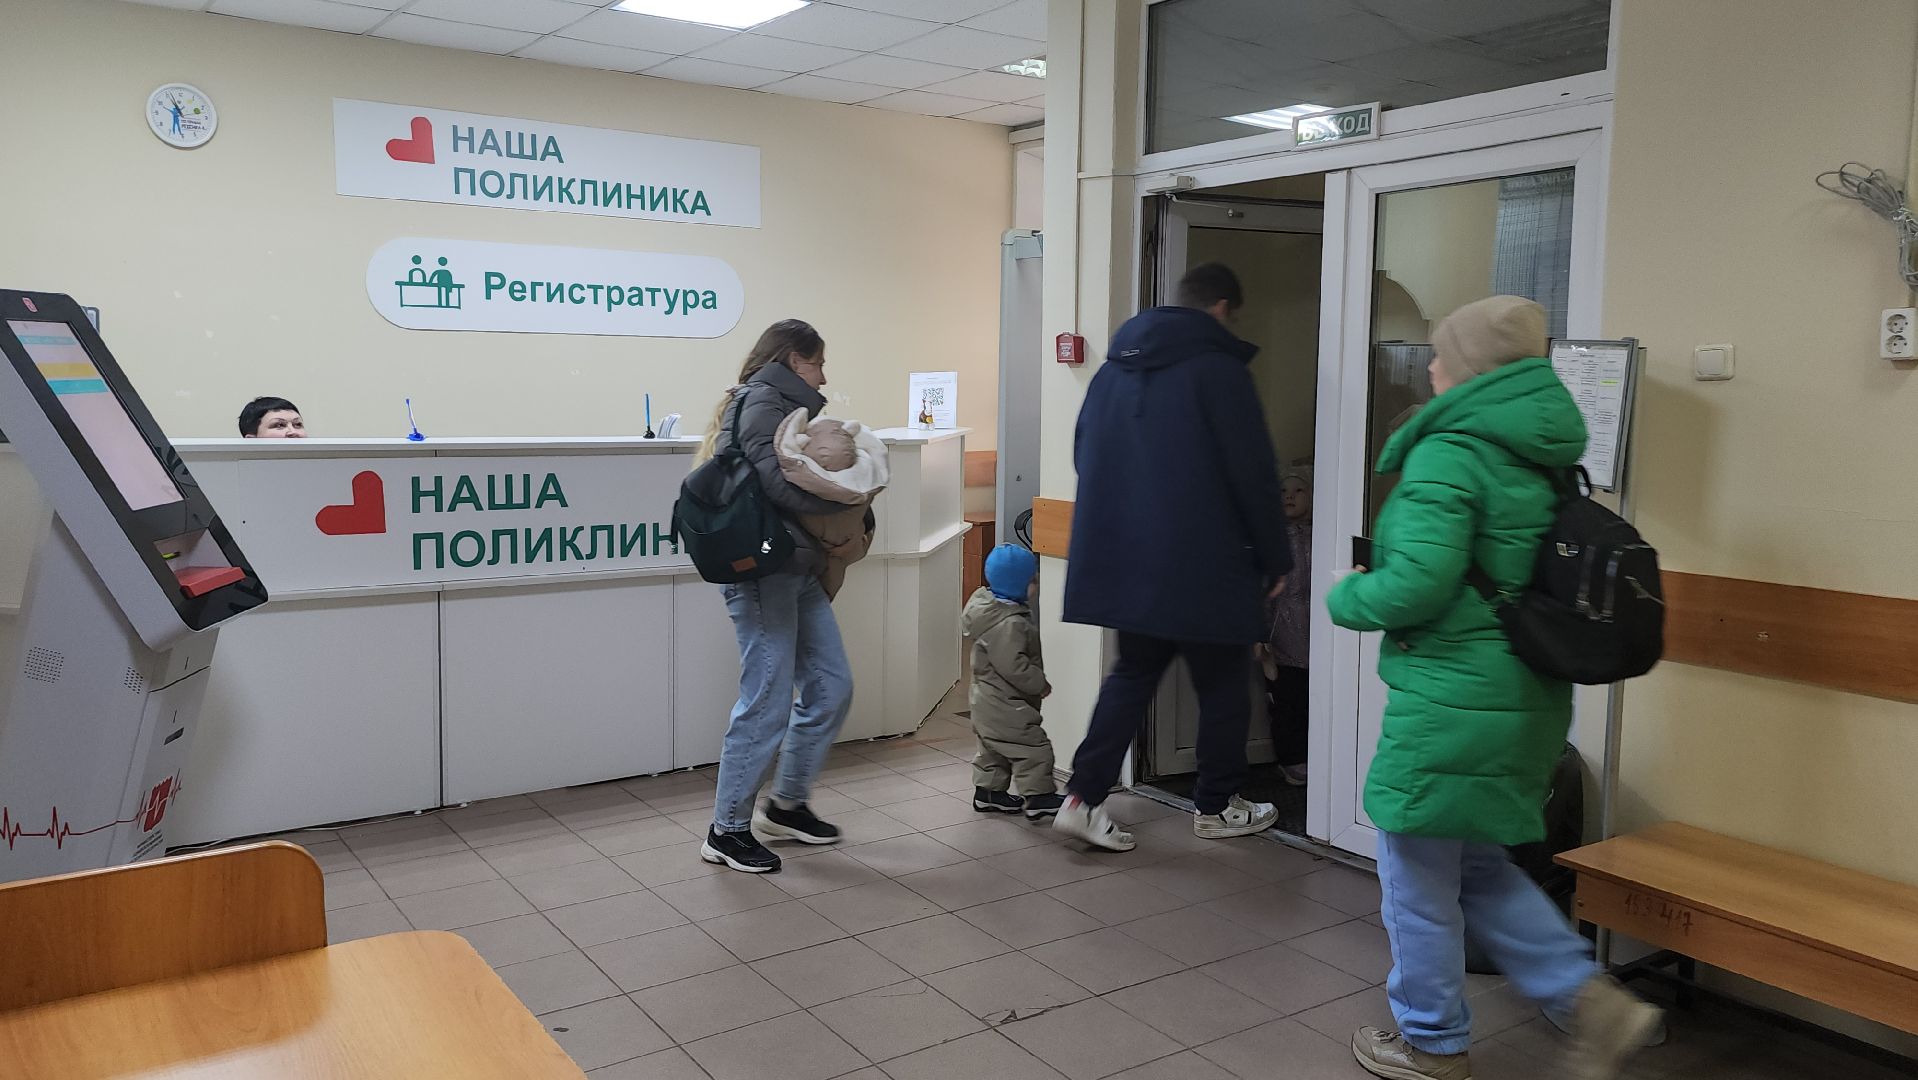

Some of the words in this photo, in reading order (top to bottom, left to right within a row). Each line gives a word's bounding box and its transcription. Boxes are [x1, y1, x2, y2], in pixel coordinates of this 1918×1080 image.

[451, 124, 564, 164] НАША
[453, 166, 712, 216] ПОЛИКЛИНИКА
[484, 271, 718, 315] Регистратура
[410, 472, 569, 514] НАША
[412, 522, 690, 570] ПОЛИКЛИН
